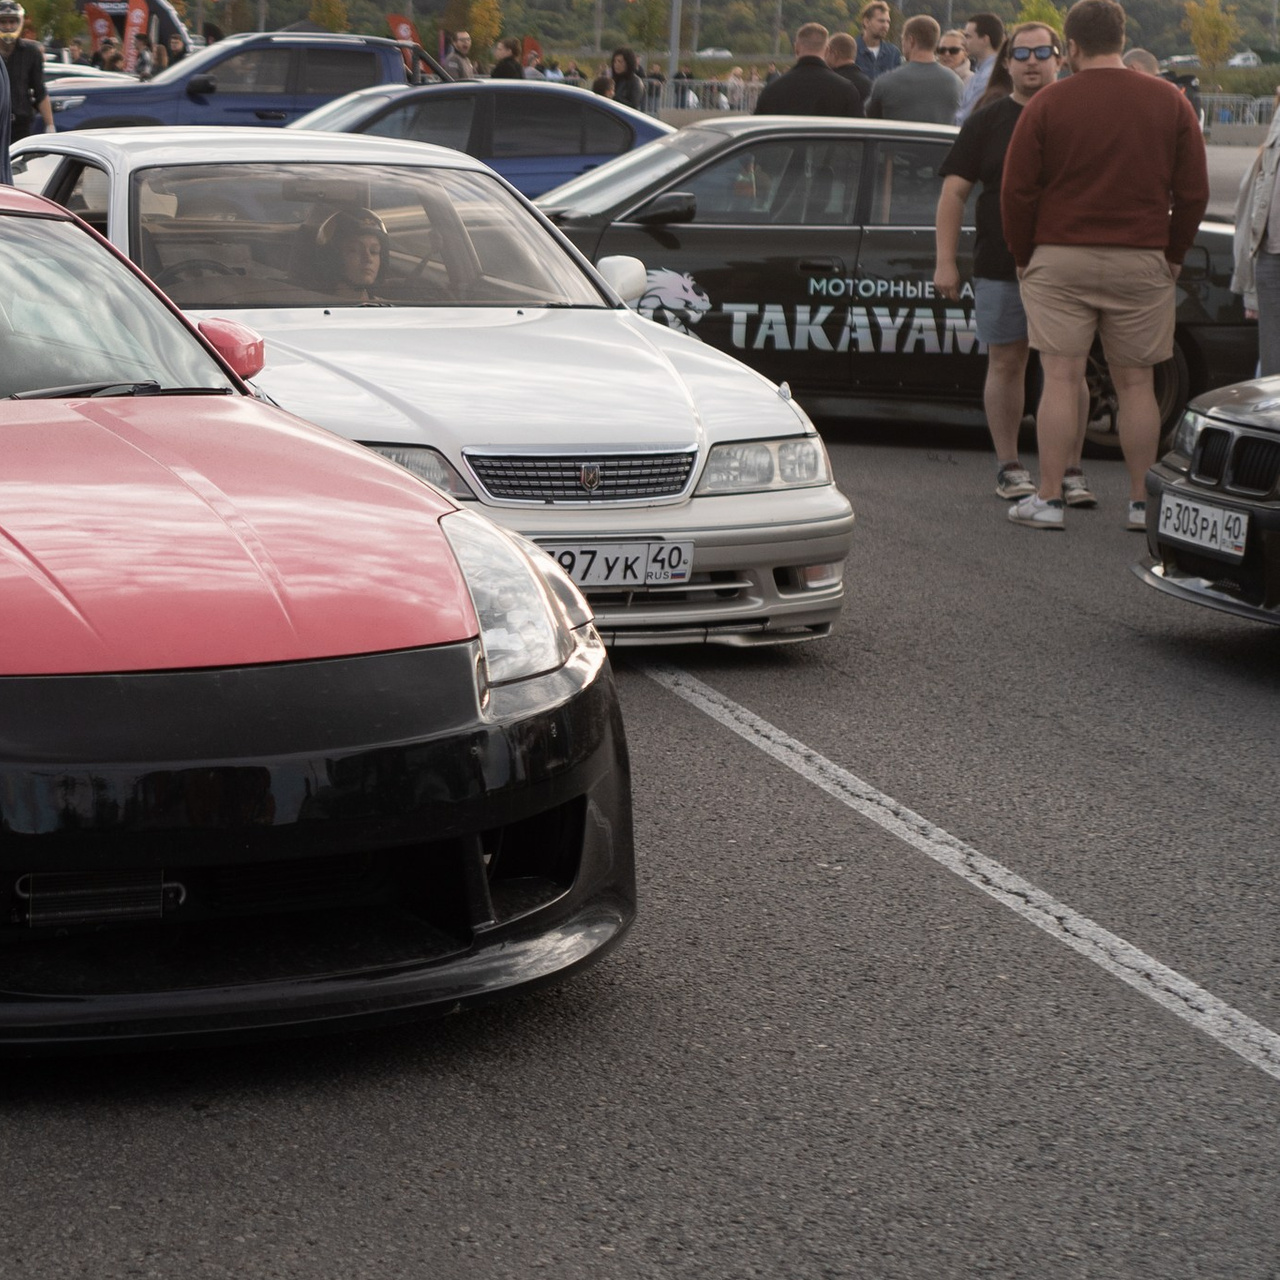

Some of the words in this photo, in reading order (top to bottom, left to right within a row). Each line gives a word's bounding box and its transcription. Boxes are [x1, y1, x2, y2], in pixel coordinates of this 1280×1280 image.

[809, 277, 935, 299] МОТОРНЫЕ
[722, 302, 989, 355] TAKAYAM
[1163, 502, 1219, 545] Р303РА
[1224, 514, 1242, 540] 40
[547, 549, 641, 581] 97УК
[651, 546, 683, 570] 40
[646, 571, 670, 581] RUS
